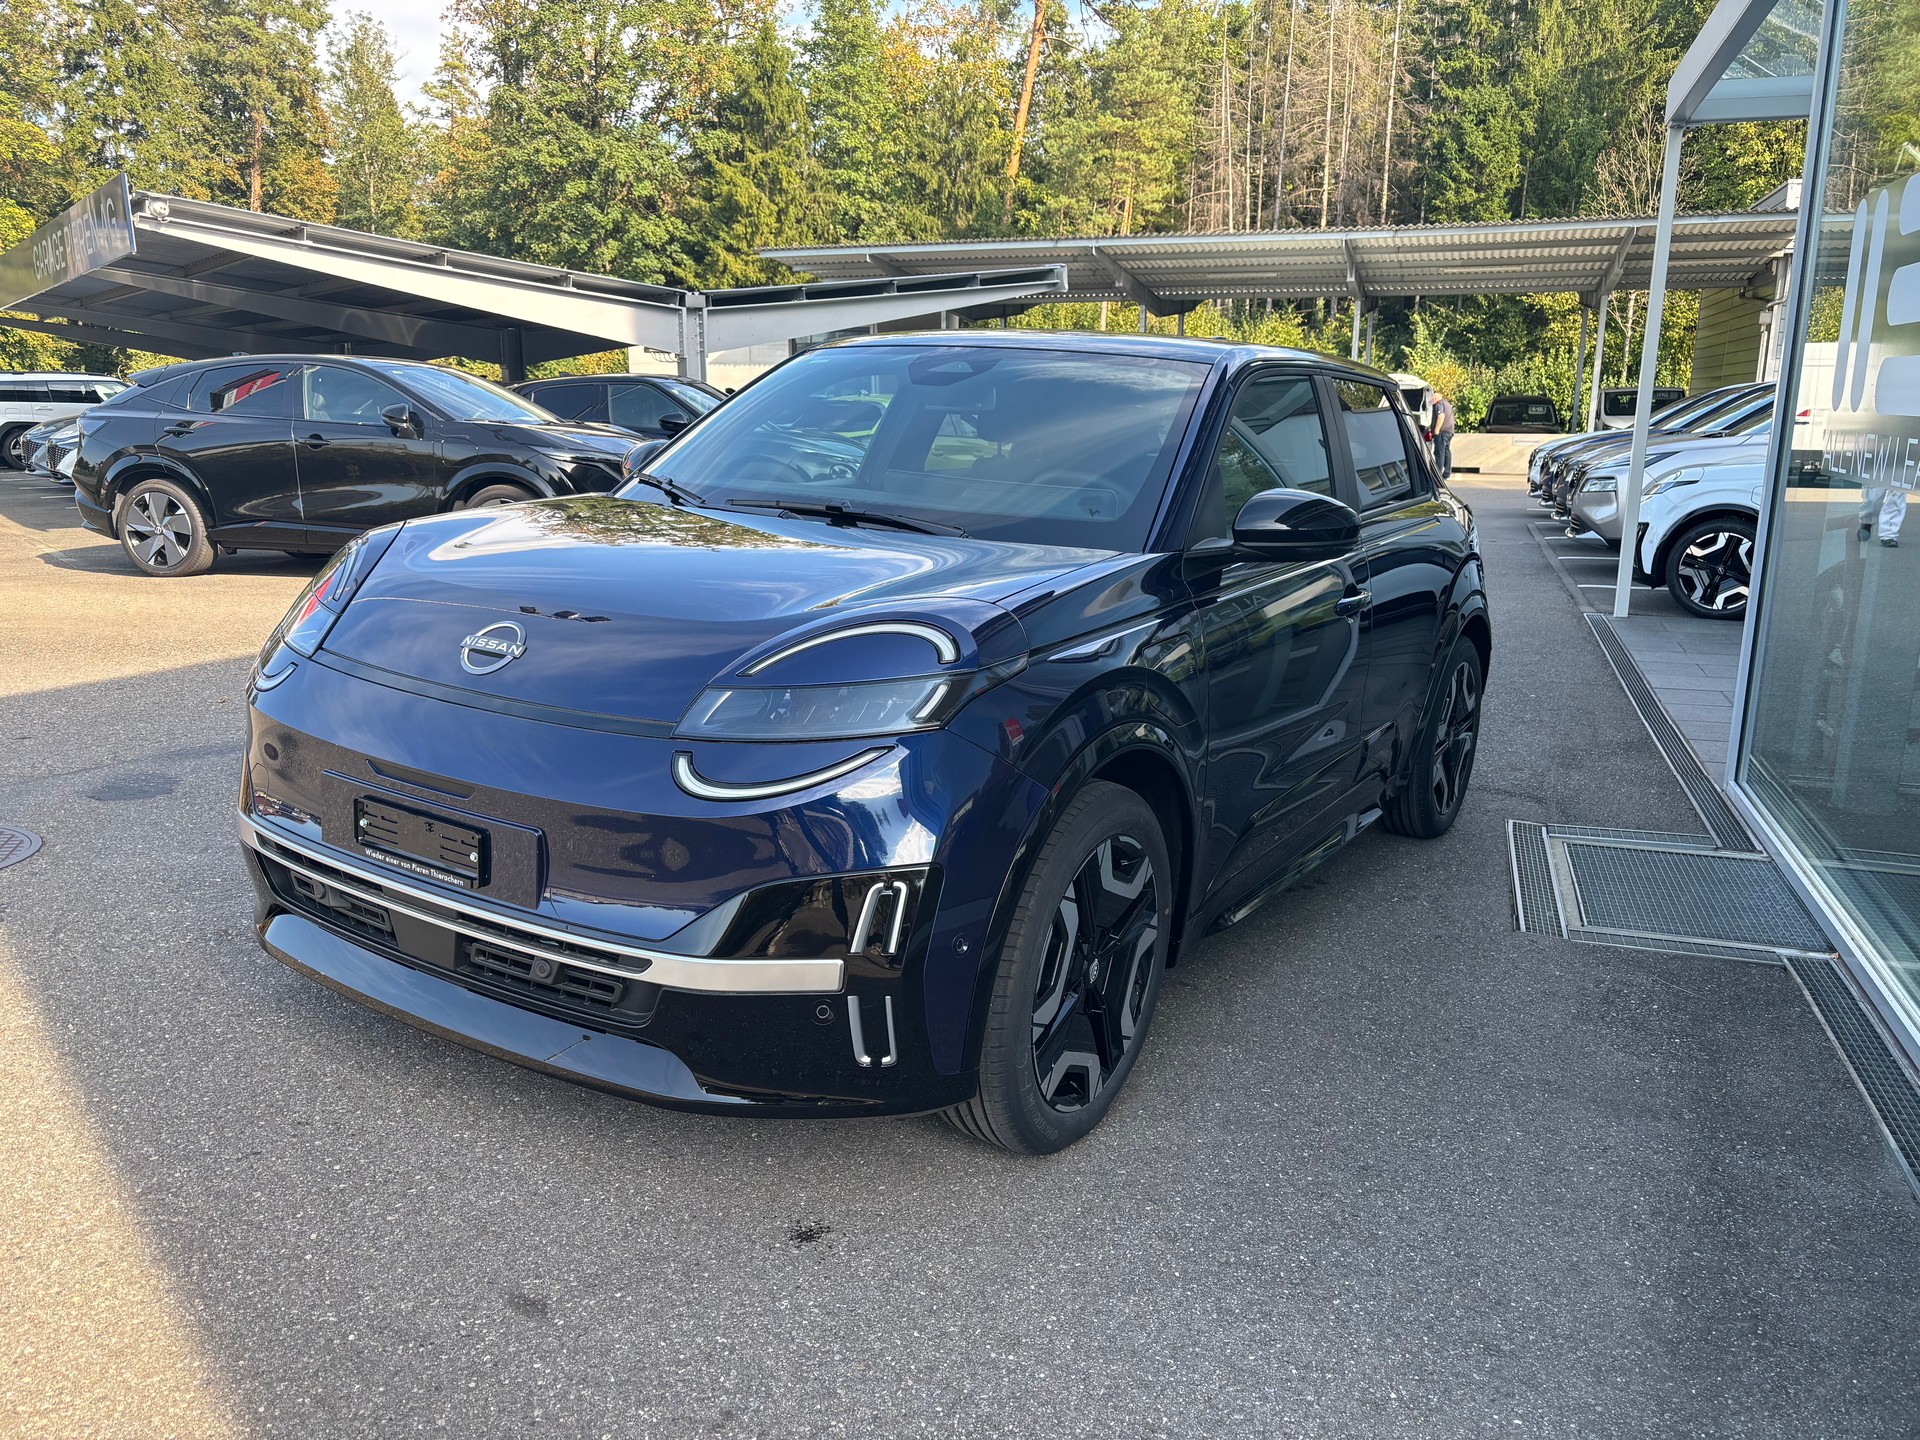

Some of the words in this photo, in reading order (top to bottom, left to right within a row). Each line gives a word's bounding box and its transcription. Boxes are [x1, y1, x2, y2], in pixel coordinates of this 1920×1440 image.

[33, 230, 66, 280] GARAGE
[63, 207, 101, 266] PIEREN
[100, 197, 118, 248] AG
[462, 636, 523, 656] NISSAN
[365, 848, 385, 860] Wieder
[385, 855, 400, 866] einer
[400, 861, 411, 869] von
[411, 863, 430, 875] Pieren
[430, 869, 464, 887] Thierachern
